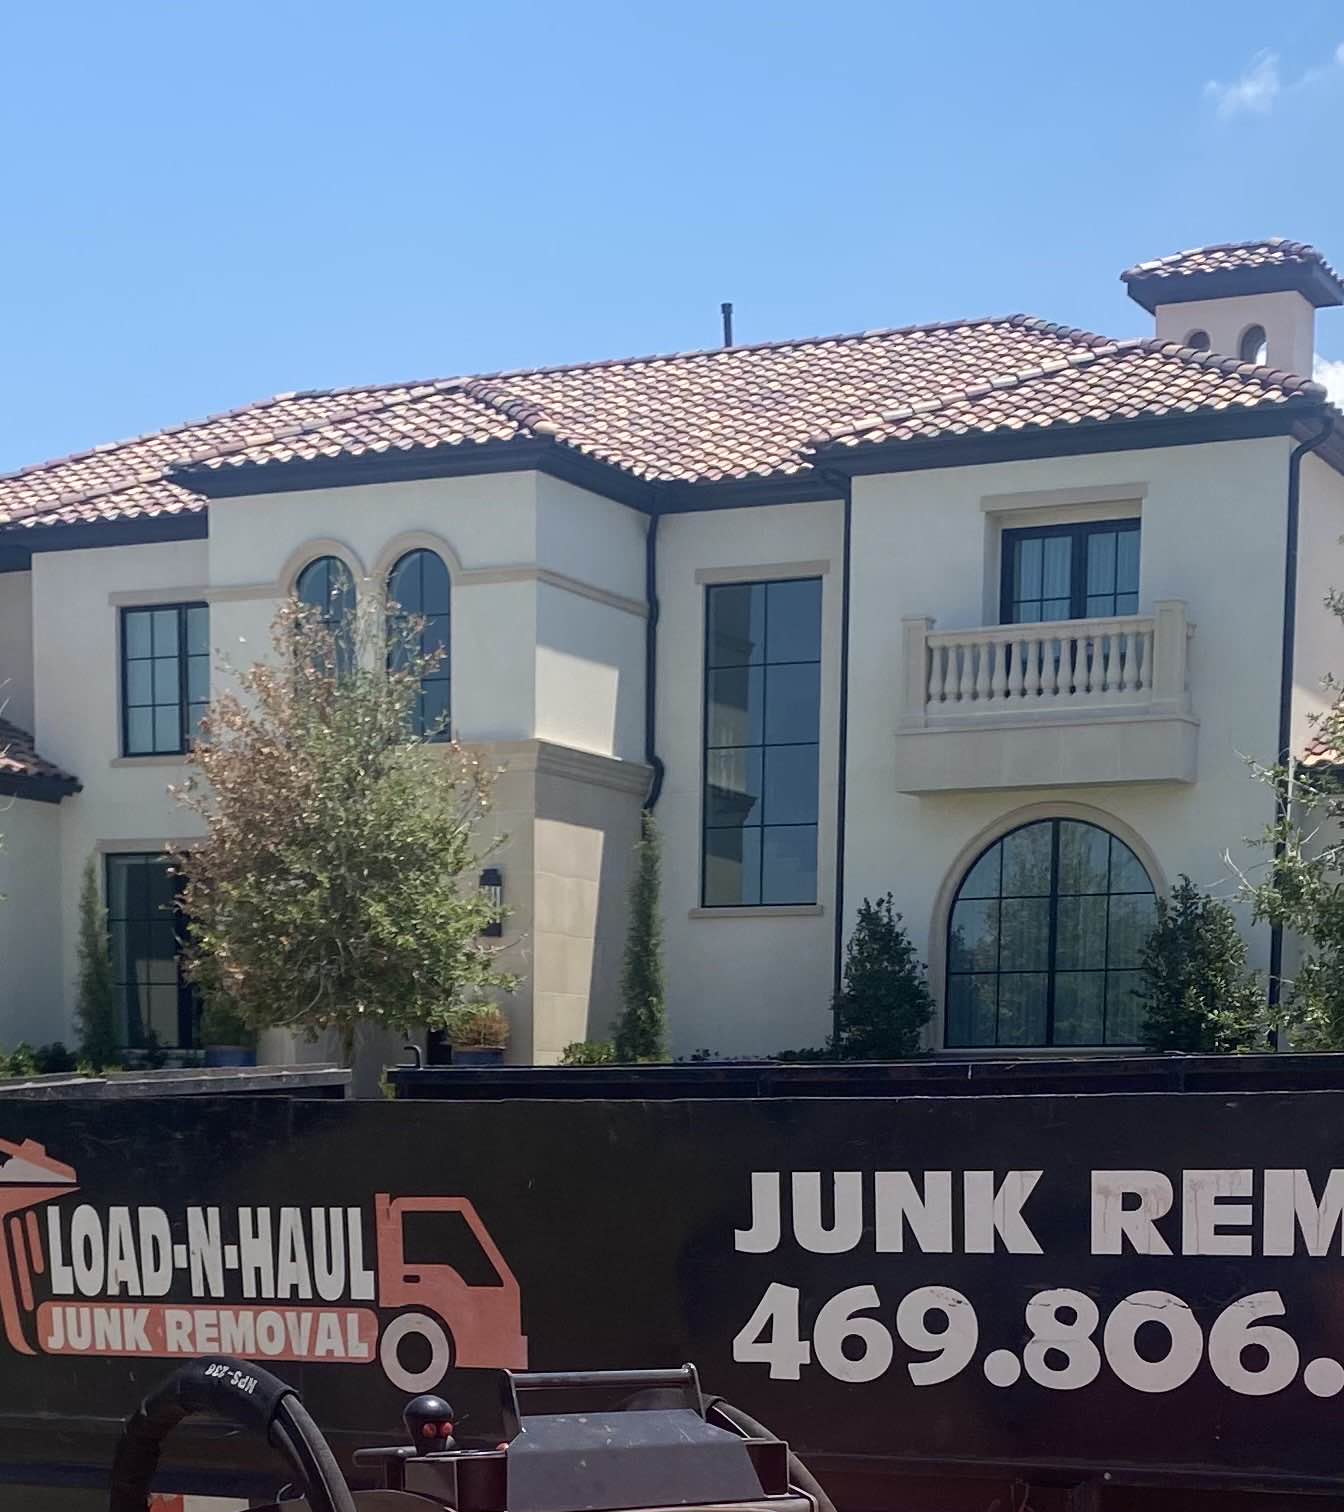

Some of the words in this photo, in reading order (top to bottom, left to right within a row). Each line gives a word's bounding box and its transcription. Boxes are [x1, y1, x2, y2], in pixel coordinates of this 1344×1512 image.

[47, 1204, 375, 1300] LOAD-N-HAUL
[733, 1169, 1045, 1254] JUNK
[47, 1306, 153, 1351] JUNK
[164, 1309, 369, 1357] REMOVAL
